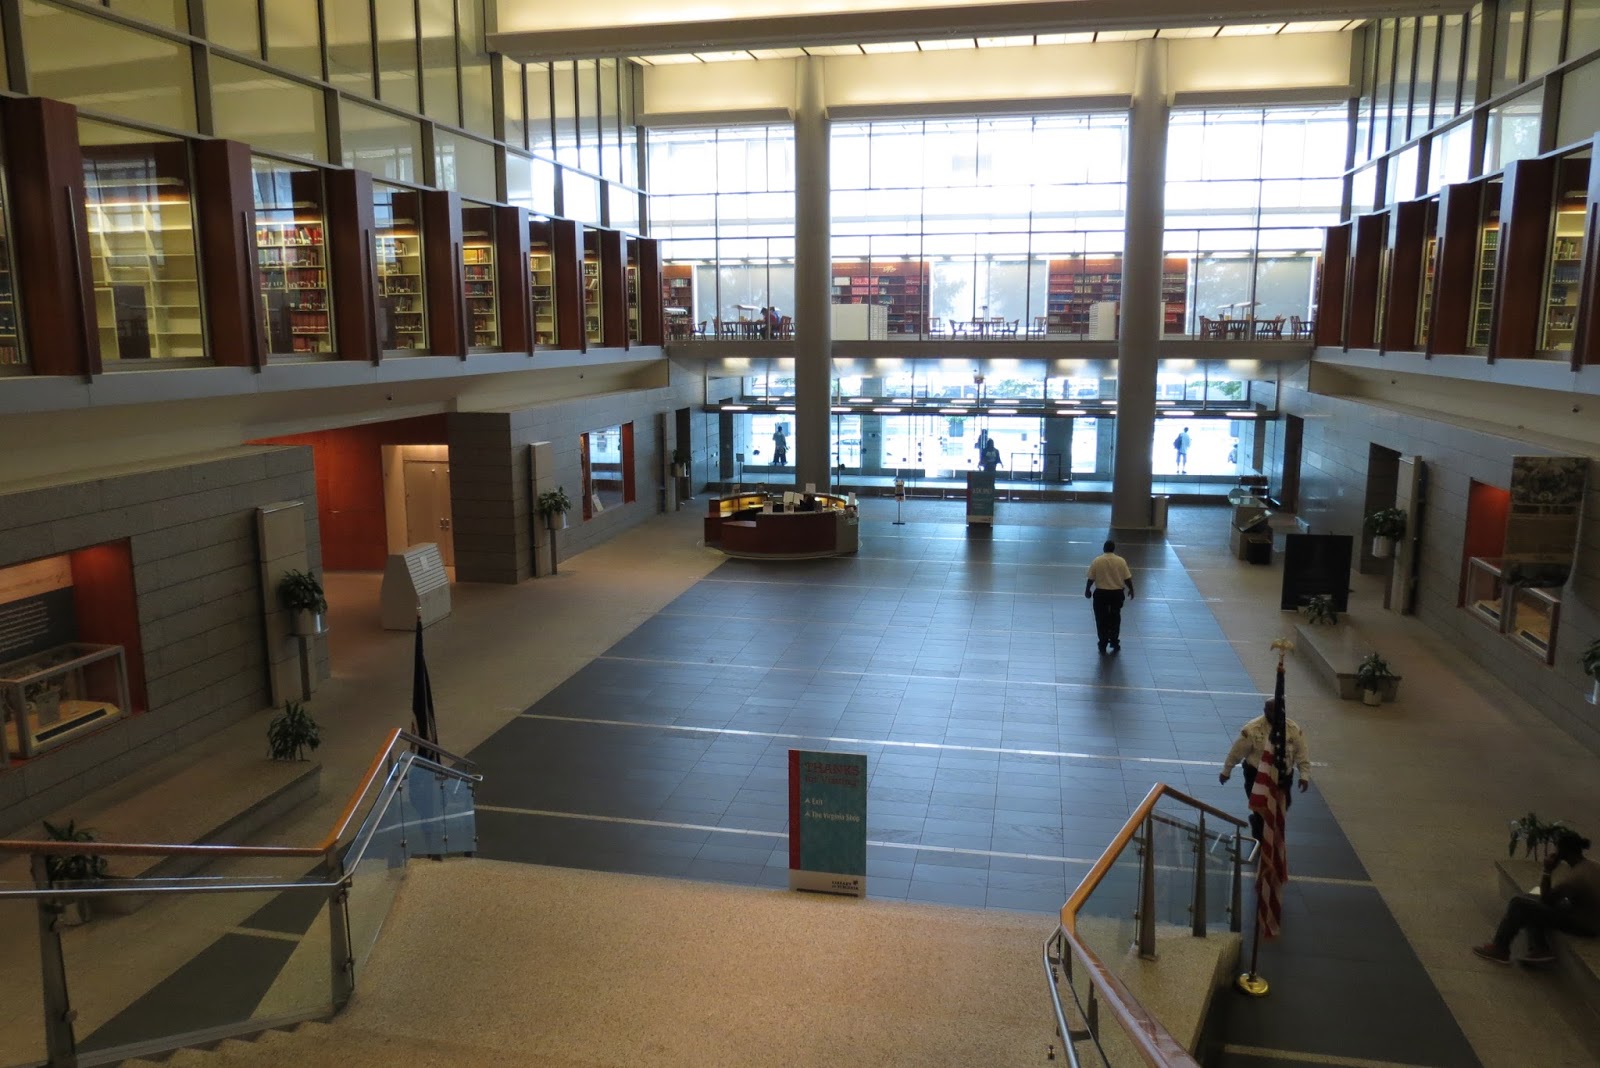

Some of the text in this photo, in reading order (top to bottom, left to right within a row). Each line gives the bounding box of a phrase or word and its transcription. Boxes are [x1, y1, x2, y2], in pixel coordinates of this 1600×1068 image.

[805, 762, 860, 776] THANKS
[812, 797, 823, 805] Exit
[812, 810, 860, 823] The Virginia Shop
